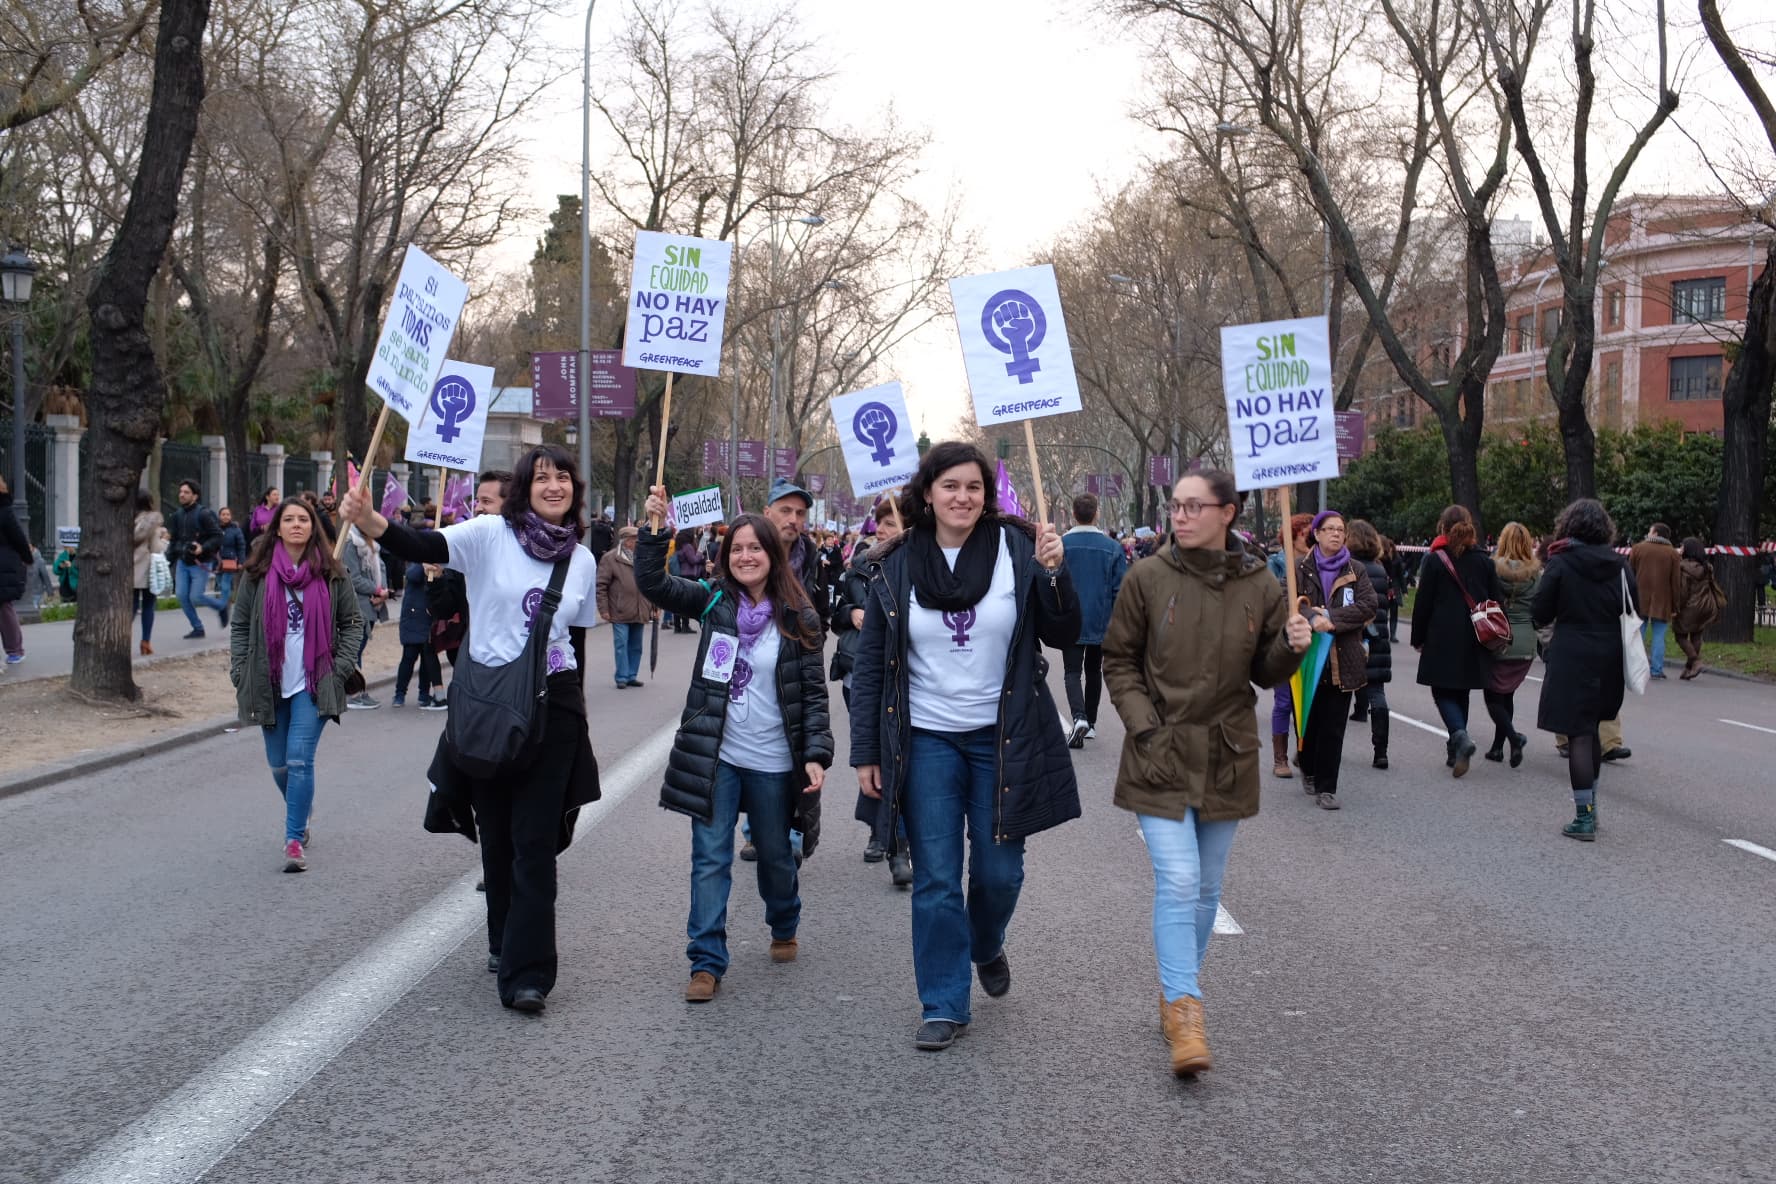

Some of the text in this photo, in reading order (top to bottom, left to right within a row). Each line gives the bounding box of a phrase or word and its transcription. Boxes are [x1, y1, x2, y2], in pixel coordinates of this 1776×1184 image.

[663, 244, 702, 269] SIN
[424, 275, 439, 297] Si
[650, 264, 709, 294] EQUIDAD
[636, 290, 720, 316] NO HAY
[639, 313, 709, 343] paz
[639, 352, 704, 368] GREENPEACE
[1256, 332, 1296, 361] SIN
[569, 355, 577, 405] AKOMFRAH
[1245, 359, 1310, 393] EQUIDAD
[991, 396, 1062, 416] GREENPEACE
[1236, 388, 1324, 419] NO HAY
[1245, 415, 1319, 458] paz
[417, 450, 467, 465] GREENPEACE
[1252, 461, 1320, 481] GREENPEACE
[675, 490, 721, 524] ¡Igualdad!
